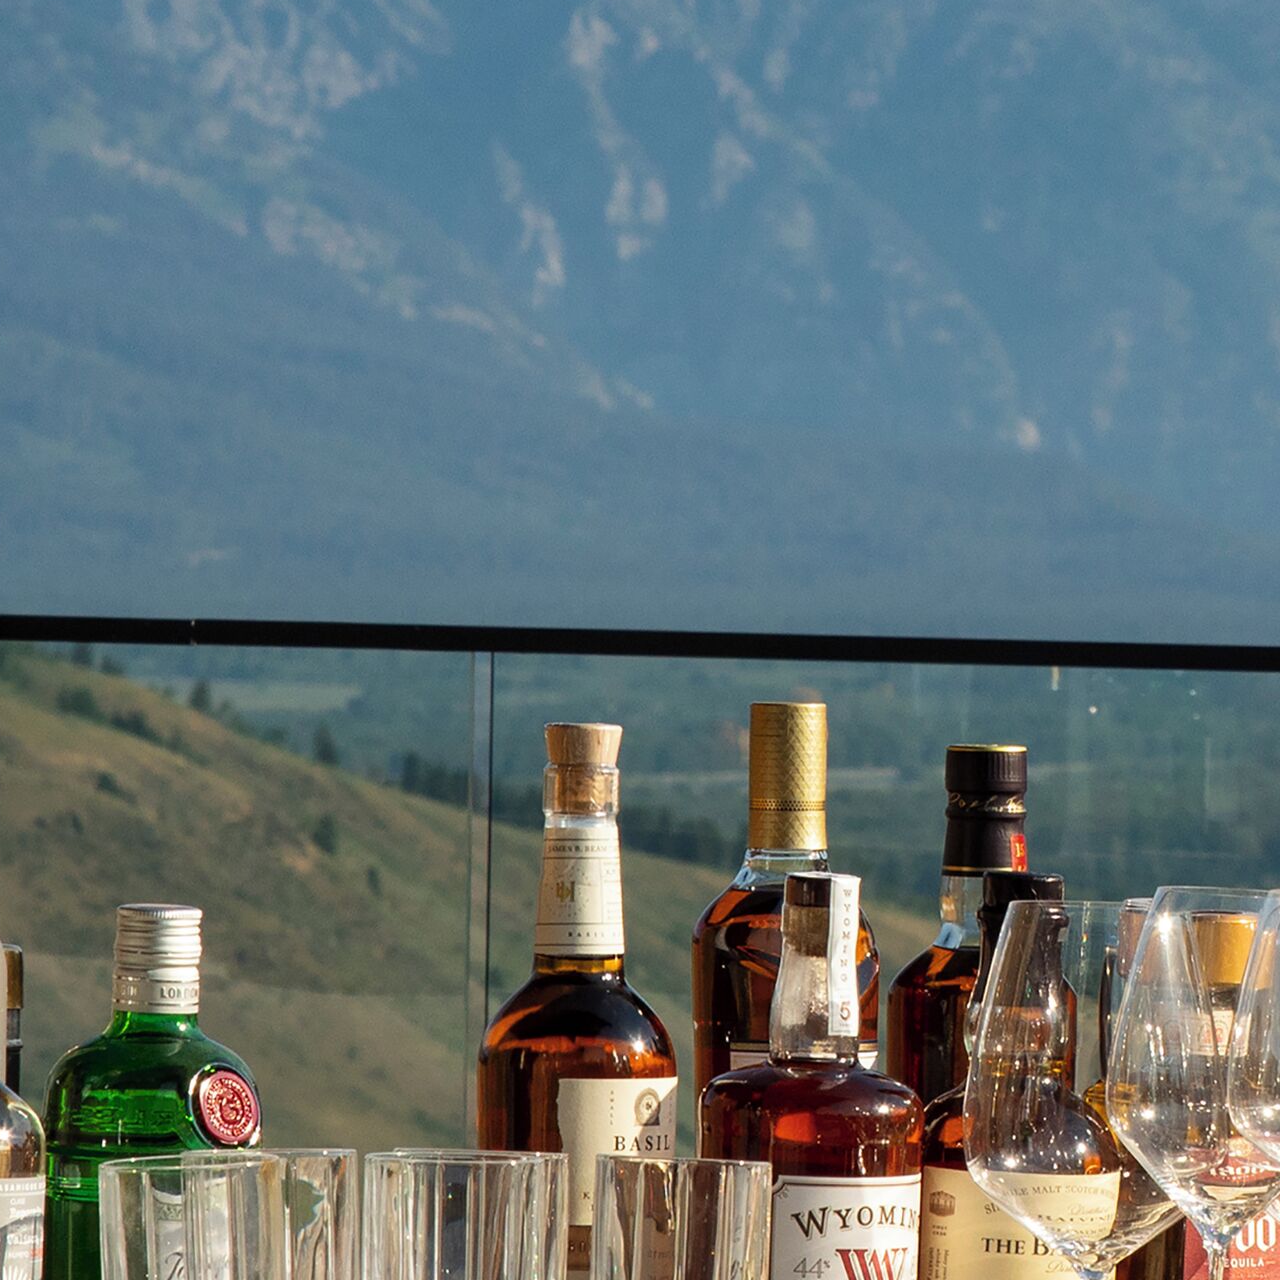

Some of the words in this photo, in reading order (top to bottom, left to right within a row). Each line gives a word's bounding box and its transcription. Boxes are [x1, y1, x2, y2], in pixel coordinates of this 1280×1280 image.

[839, 888, 852, 983] WYOMING
[839, 1000, 851, 1021] 5
[614, 1134, 670, 1152] BASIL
[1032, 1185, 1062, 1195] MALT
[981, 1236, 1026, 1256] THE
[793, 1257, 831, 1279] 44%
[1224, 1257, 1265, 1268] EQUILA
